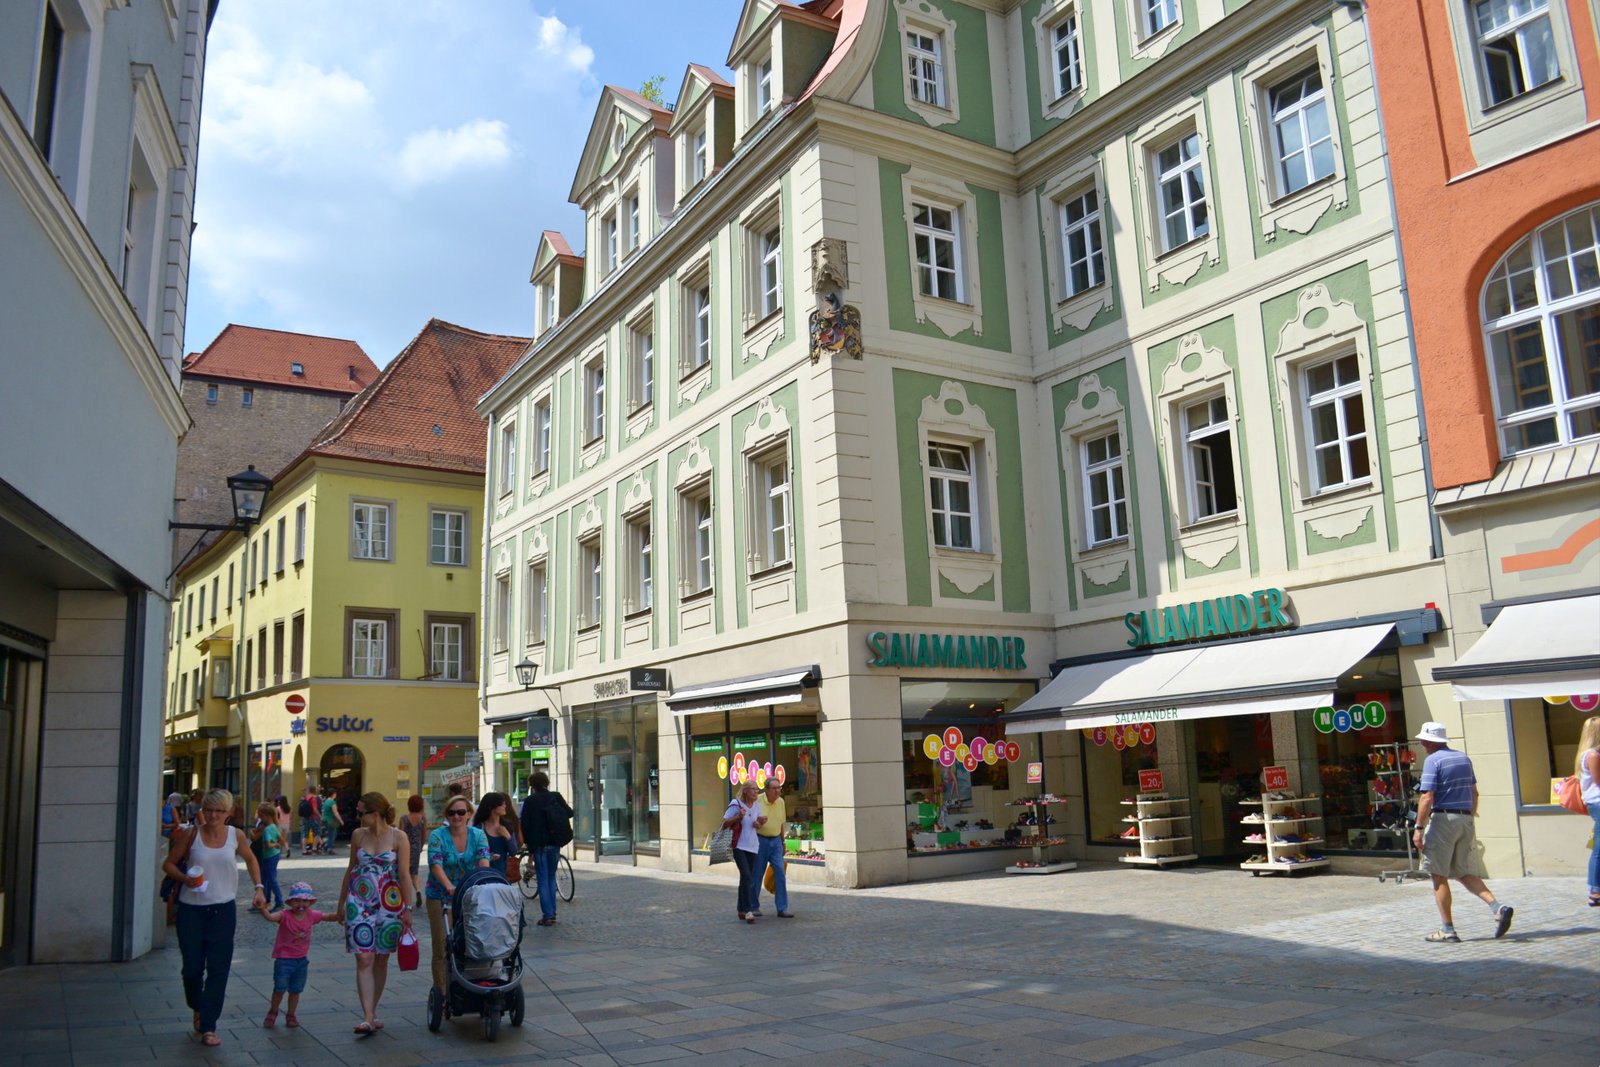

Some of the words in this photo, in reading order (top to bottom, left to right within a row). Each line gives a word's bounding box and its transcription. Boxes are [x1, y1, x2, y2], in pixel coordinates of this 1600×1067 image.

[1125, 587, 1288, 647] SALAMANDER
[866, 631, 1027, 671] SALAMANDER
[1115, 707, 1179, 723] SALAMANDER
[1318, 704, 1380, 729] NEU!
[927, 731, 1017, 768] REDUZIERT
[718, 756, 784, 786] REDUIERT
